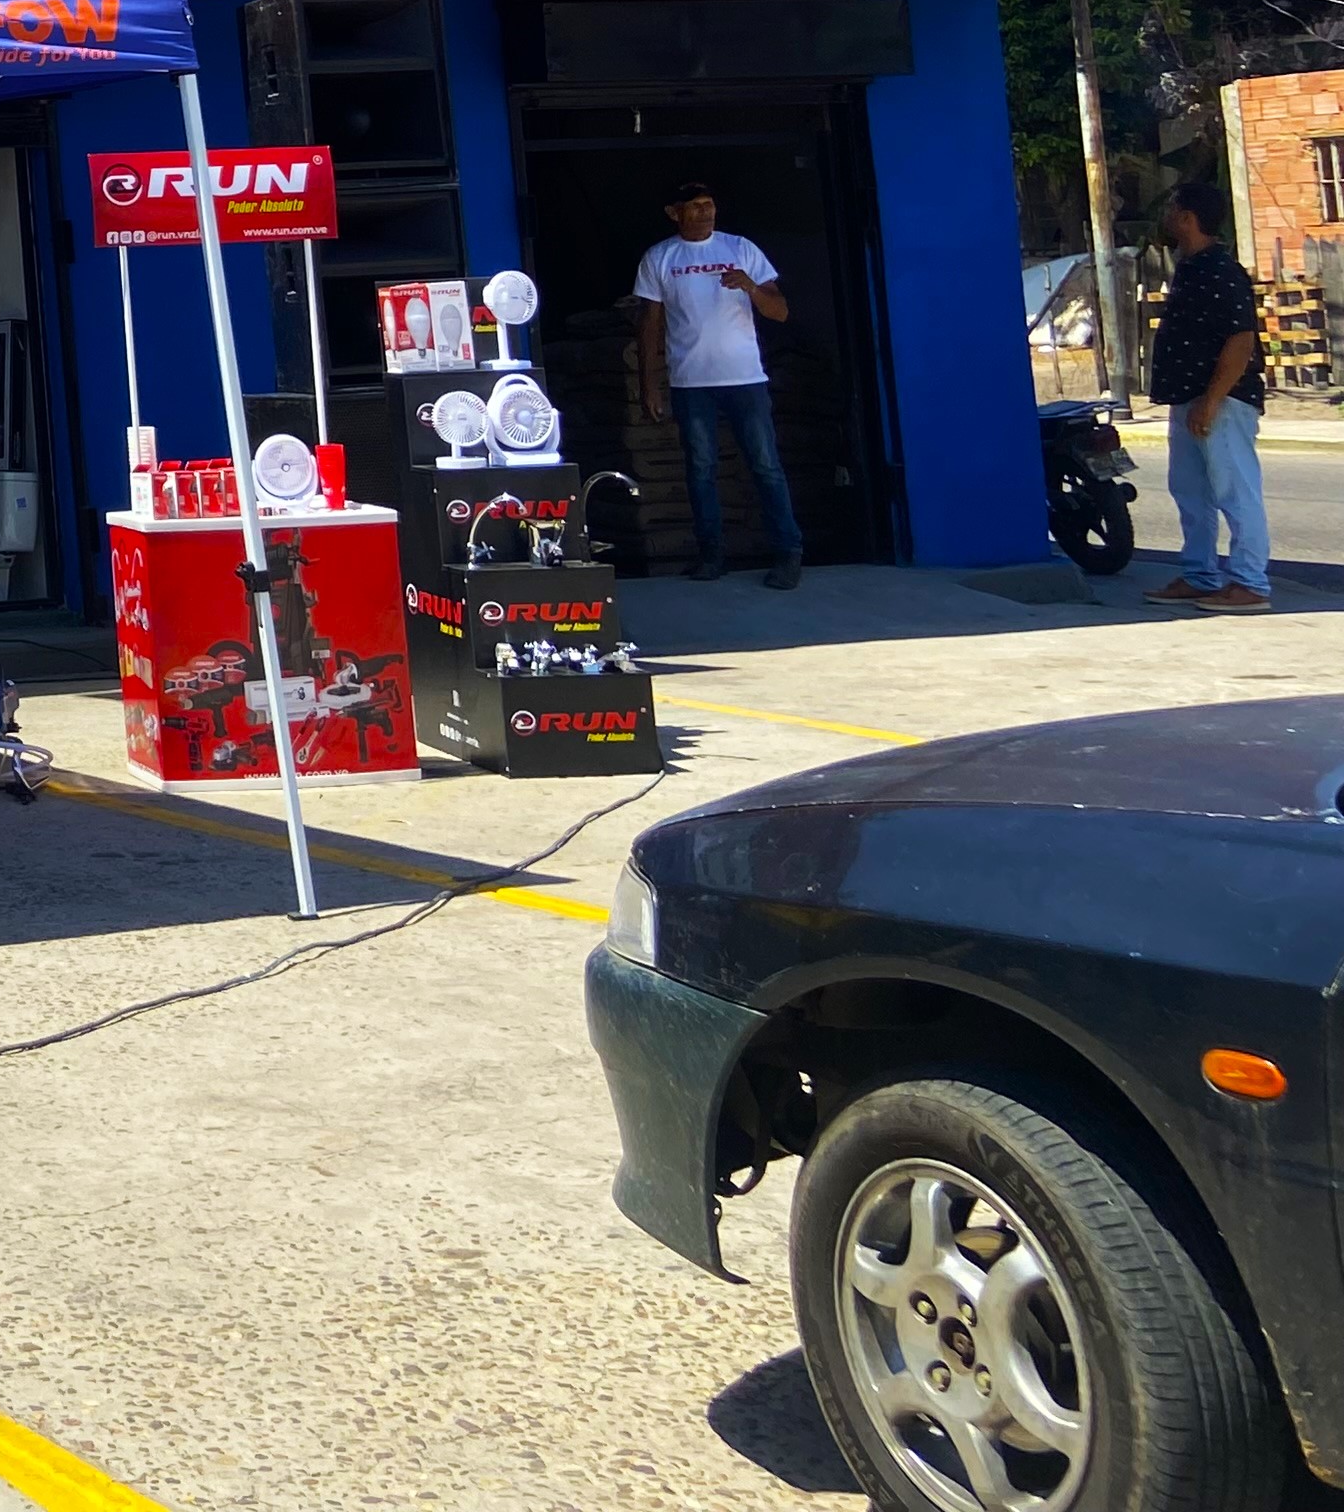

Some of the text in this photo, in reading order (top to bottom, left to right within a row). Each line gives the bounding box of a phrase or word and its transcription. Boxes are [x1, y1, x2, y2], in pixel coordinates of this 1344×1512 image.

[35, 47, 70, 67] for
[147, 162, 311, 198] RUN
[227, 198, 305, 214] Poder Absoluto
[146, 225, 329, 243] @run.vnzl www.run.com.ve
[507, 601, 604, 622] RUN
[539, 711, 637, 732] RUN
